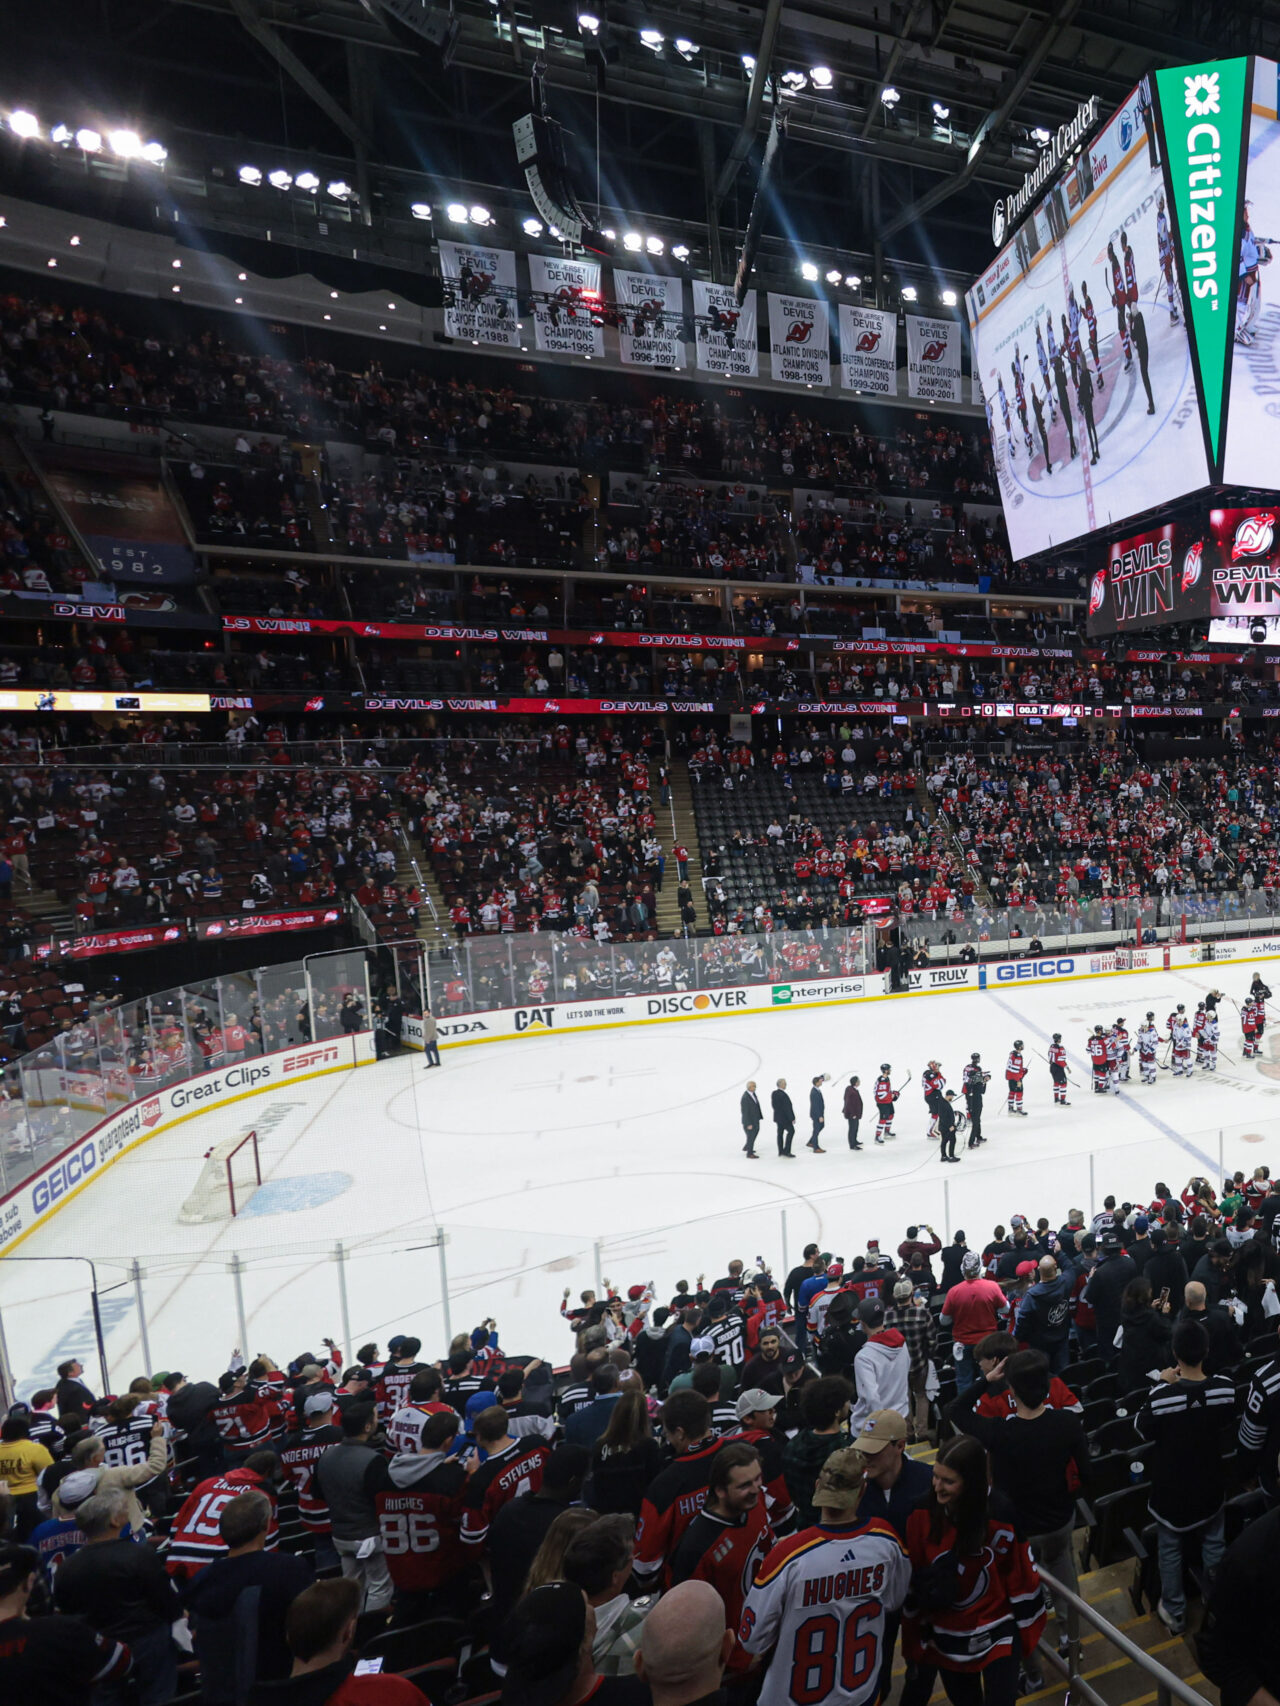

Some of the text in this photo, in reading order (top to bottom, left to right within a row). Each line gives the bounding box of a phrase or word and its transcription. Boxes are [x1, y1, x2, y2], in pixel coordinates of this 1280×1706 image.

[1006, 96, 1097, 226] Prudential Center
[1187, 123, 1221, 299] Citizens
[458, 257, 498, 272] DEVILS
[548, 270, 584, 285] DEVILS
[631, 284, 666, 298] DEVILS
[709, 296, 741, 309] DEVILS
[780, 299, 817, 311] NEW JERSEY
[783, 306, 814, 320] DEVILS
[850, 310, 885, 322] NEW JERSEY
[447, 313, 517, 334] PLAYOFF CHAMPIONS
[853, 317, 882, 331] DEVILS
[917, 320, 950, 331] NEW JERSEY
[457, 327, 510, 343] 1987-1988
[544, 326, 595, 342] CHAMPIONS
[920, 328, 948, 340] DEVILS
[545, 340, 595, 354] 1994-1995
[632, 338, 672, 354] CHAMPIONS
[772, 344, 828, 360] ATLANTIC DIVISION
[630, 352, 677, 365] 1996-1997
[708, 347, 746, 363] CHAMPIONS
[842, 353, 896, 371] EASTERN CONFERENCE
[706, 359, 750, 374] 1997-1998
[782, 358, 819, 372] CHAMPIONS
[910, 363, 961, 379] ATLANTIC DIVISION
[780, 370, 823, 383] 1998-1999
[850, 366, 890, 382] CHAMPIONS
[849, 378, 889, 392] 1999-2000
[919, 376, 952, 390] CHAMPIONS
[917, 387, 956, 400] 2000-2001
[1111, 537, 1173, 583] DEVILS
[1112, 565, 1174, 621] WIN
[255, 618, 311, 632] WIN!
[424, 627, 548, 641] DEVILS WIN!
[639, 634, 745, 648] DEVILS WIN!
[365, 699, 497, 710] DEVILS WIN!
[600, 701, 713, 712] DEVILS WIN!
[1019, 705, 1081, 715] 00.0 4
[929, 968, 968, 983] TRULY
[996, 959, 1075, 981] GEICO
[647, 990, 747, 1016] DISCOVER
[514, 1006, 555, 1031] CAT
[566, 1010, 583, 1020] LET'S
[584, 1010, 593, 1018] DO
[594, 1008, 605, 1017] THE
[282, 1046, 338, 1073] ESPN
[170, 1063, 271, 1109] Great Clips
[142, 1101, 161, 1119] Rate
[98, 1109, 140, 1163] guaranteed
[32, 1142, 96, 1215] GEICO
[5, 1204, 19, 1223] sub
[108, 1432, 142, 1448] HUGHES
[104, 1440, 147, 1468] 86
[498, 1453, 543, 1491] STEVENS
[212, 1477, 252, 1495] ZAJAC
[385, 1496, 424, 1512] HUGHES
[379, 1513, 439, 1555] 86
[988, 1528, 1015, 1556] C
[803, 1563, 886, 1608] HUGHES
[788, 1599, 884, 1706] 86
